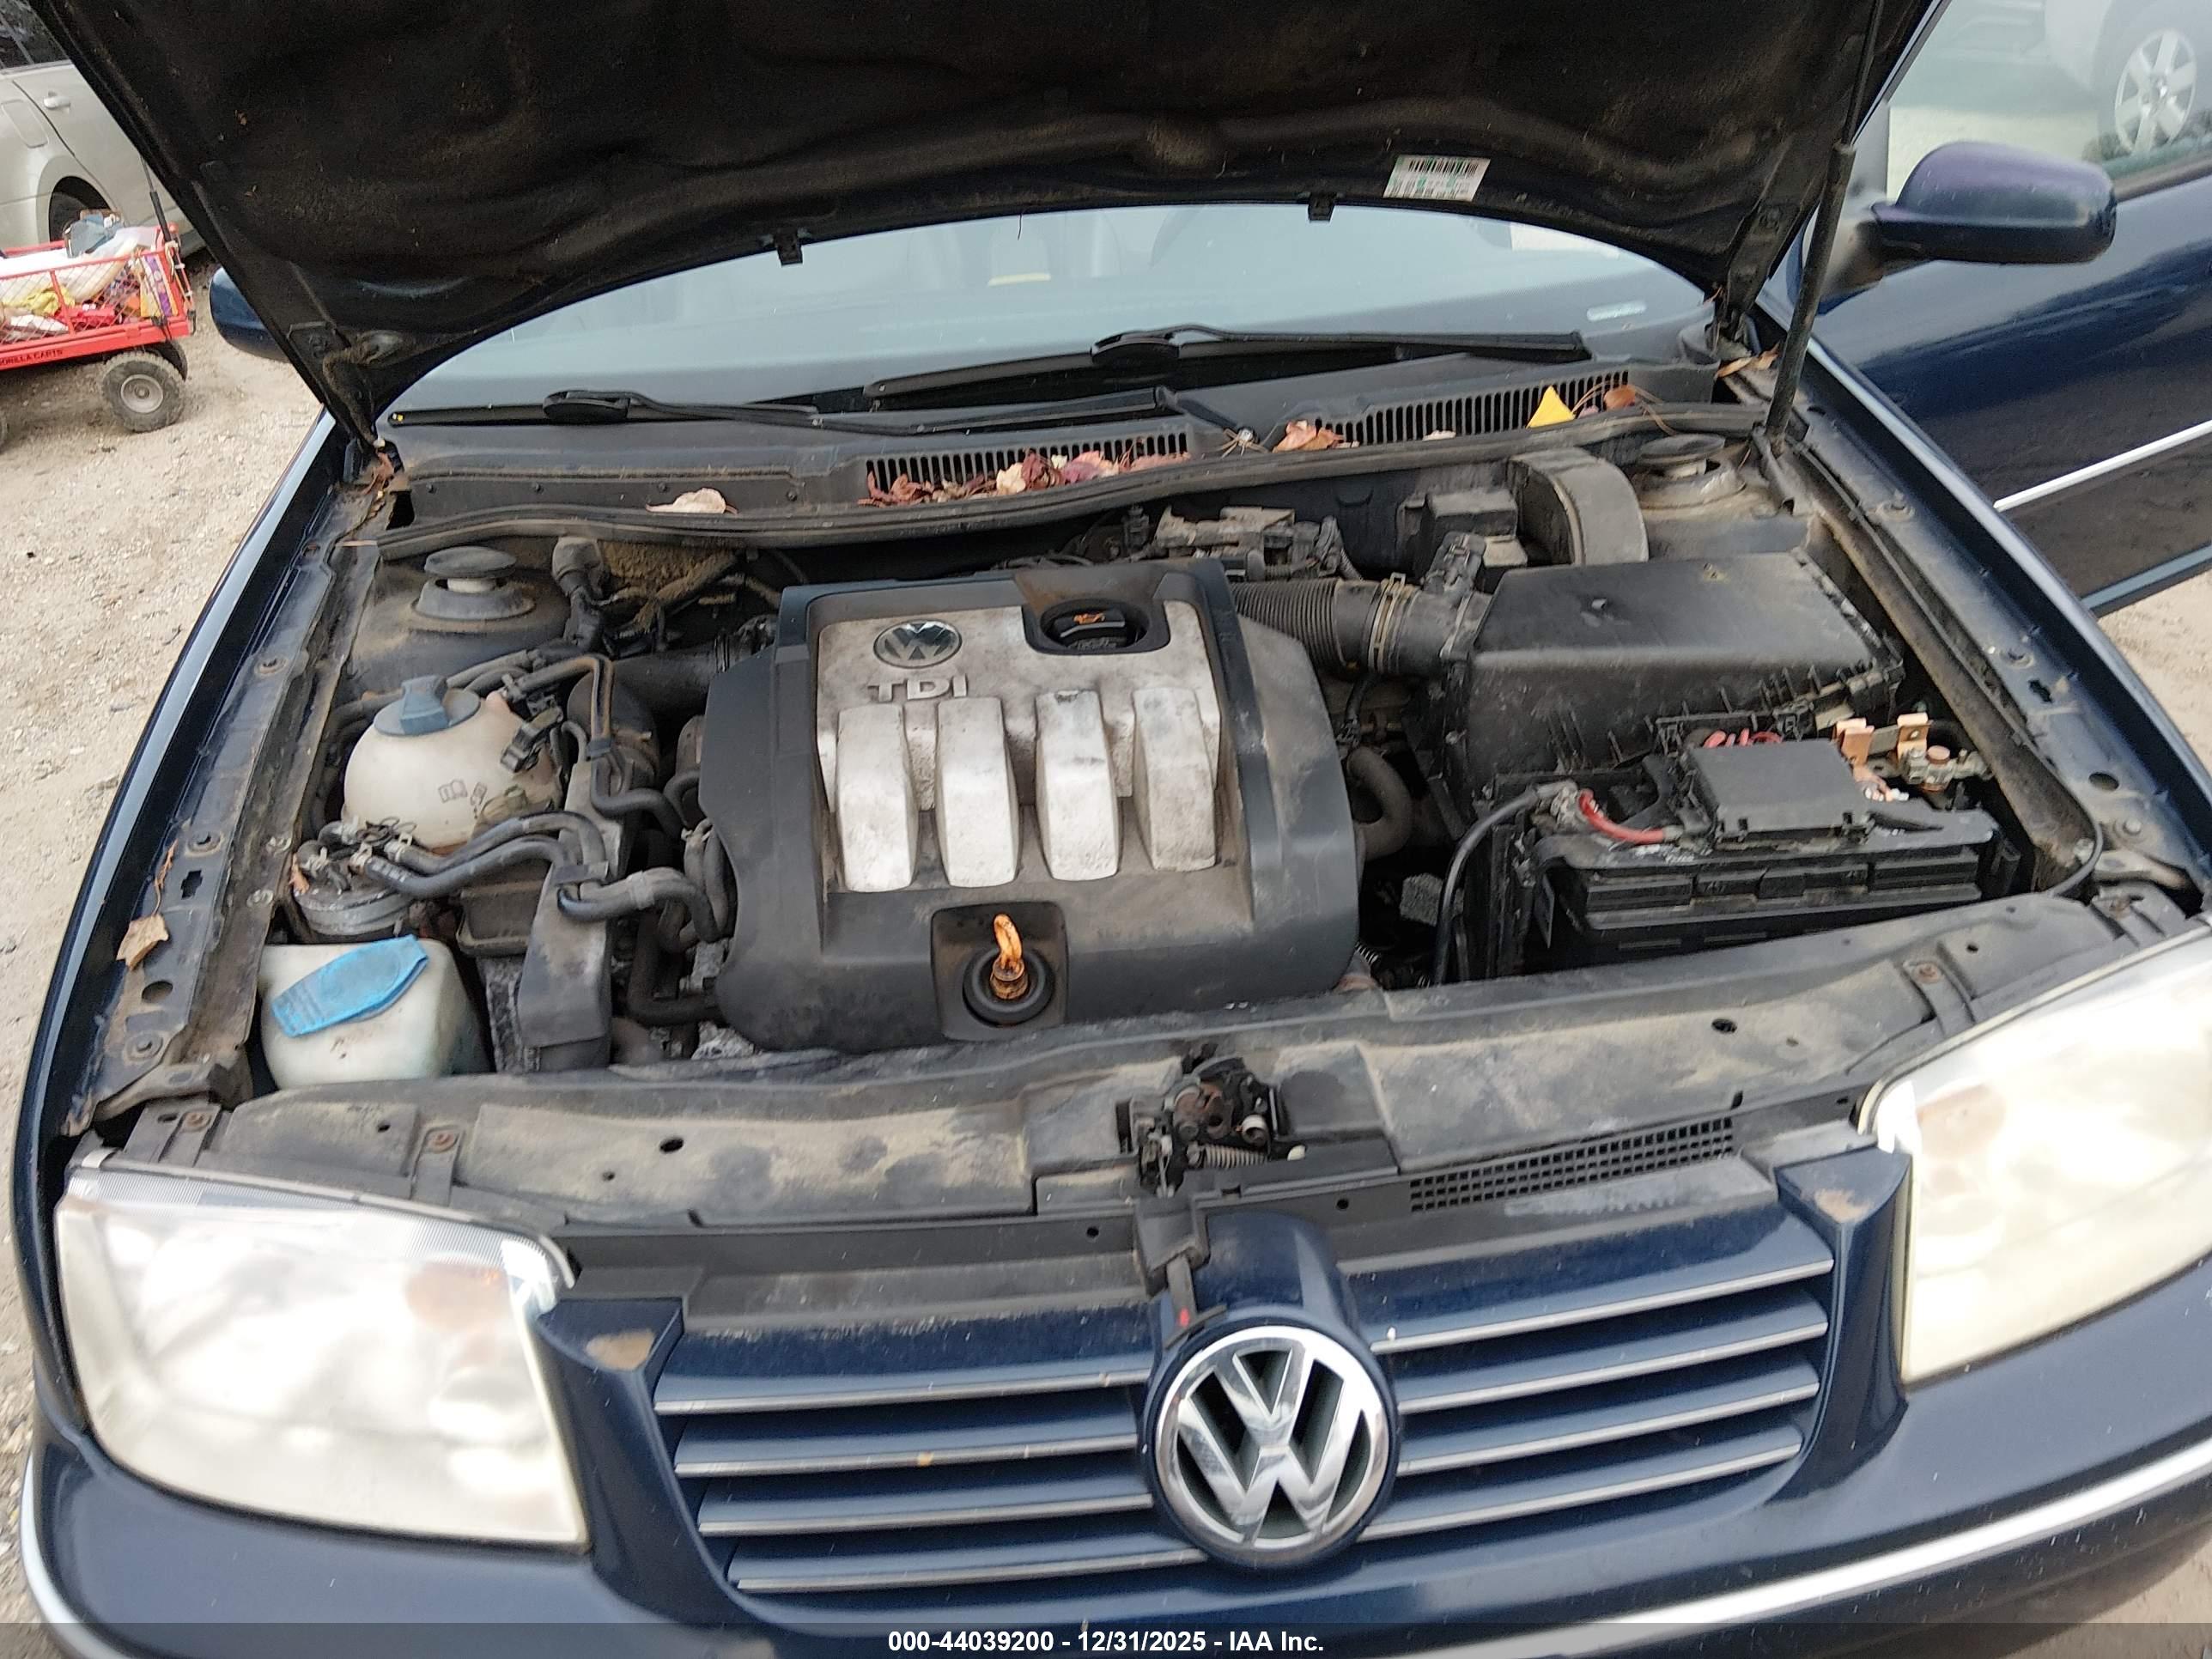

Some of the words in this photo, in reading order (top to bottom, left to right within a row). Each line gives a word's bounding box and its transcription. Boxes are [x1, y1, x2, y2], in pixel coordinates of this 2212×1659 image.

[0, 353, 32, 366] ORILLA
[866, 673, 969, 703] TDI
[1166, 1331, 1381, 1549] VW
